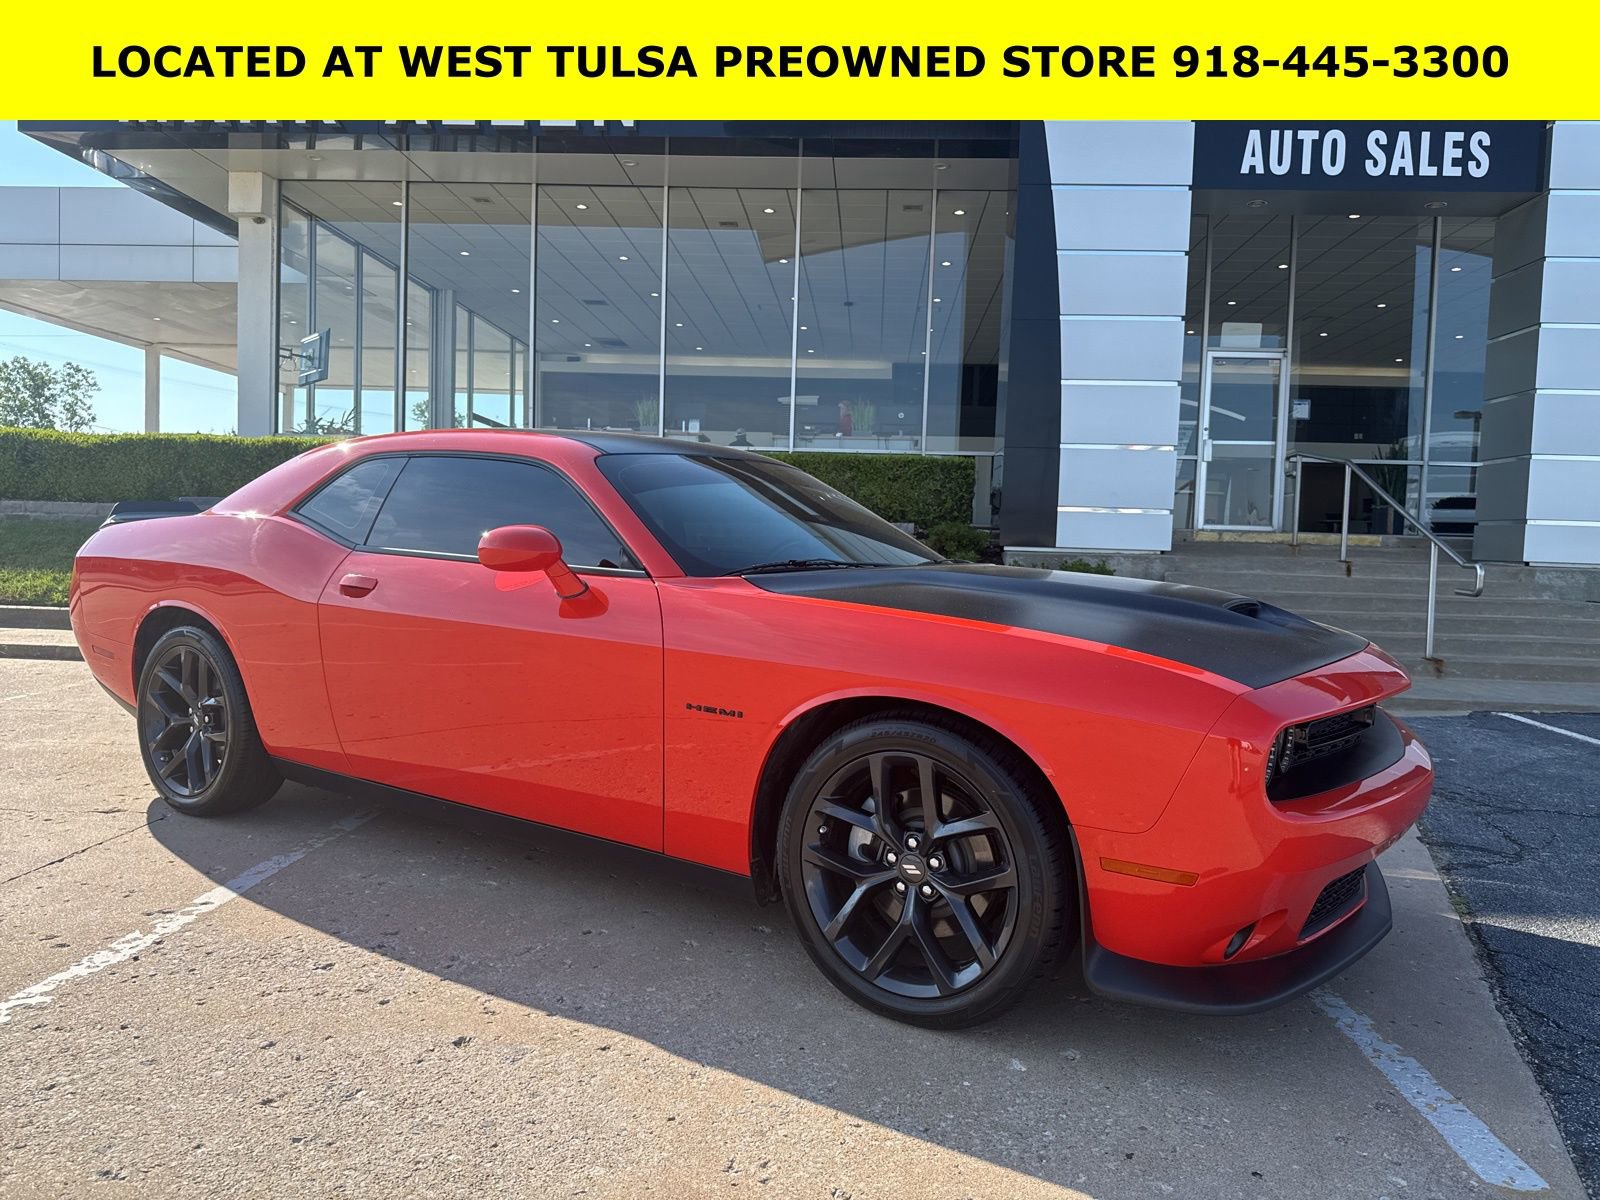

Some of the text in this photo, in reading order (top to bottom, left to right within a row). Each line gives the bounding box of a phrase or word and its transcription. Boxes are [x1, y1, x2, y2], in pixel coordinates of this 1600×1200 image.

[1240, 129, 1491, 178] AUTO SALES
[686, 703, 744, 718] HEMI
